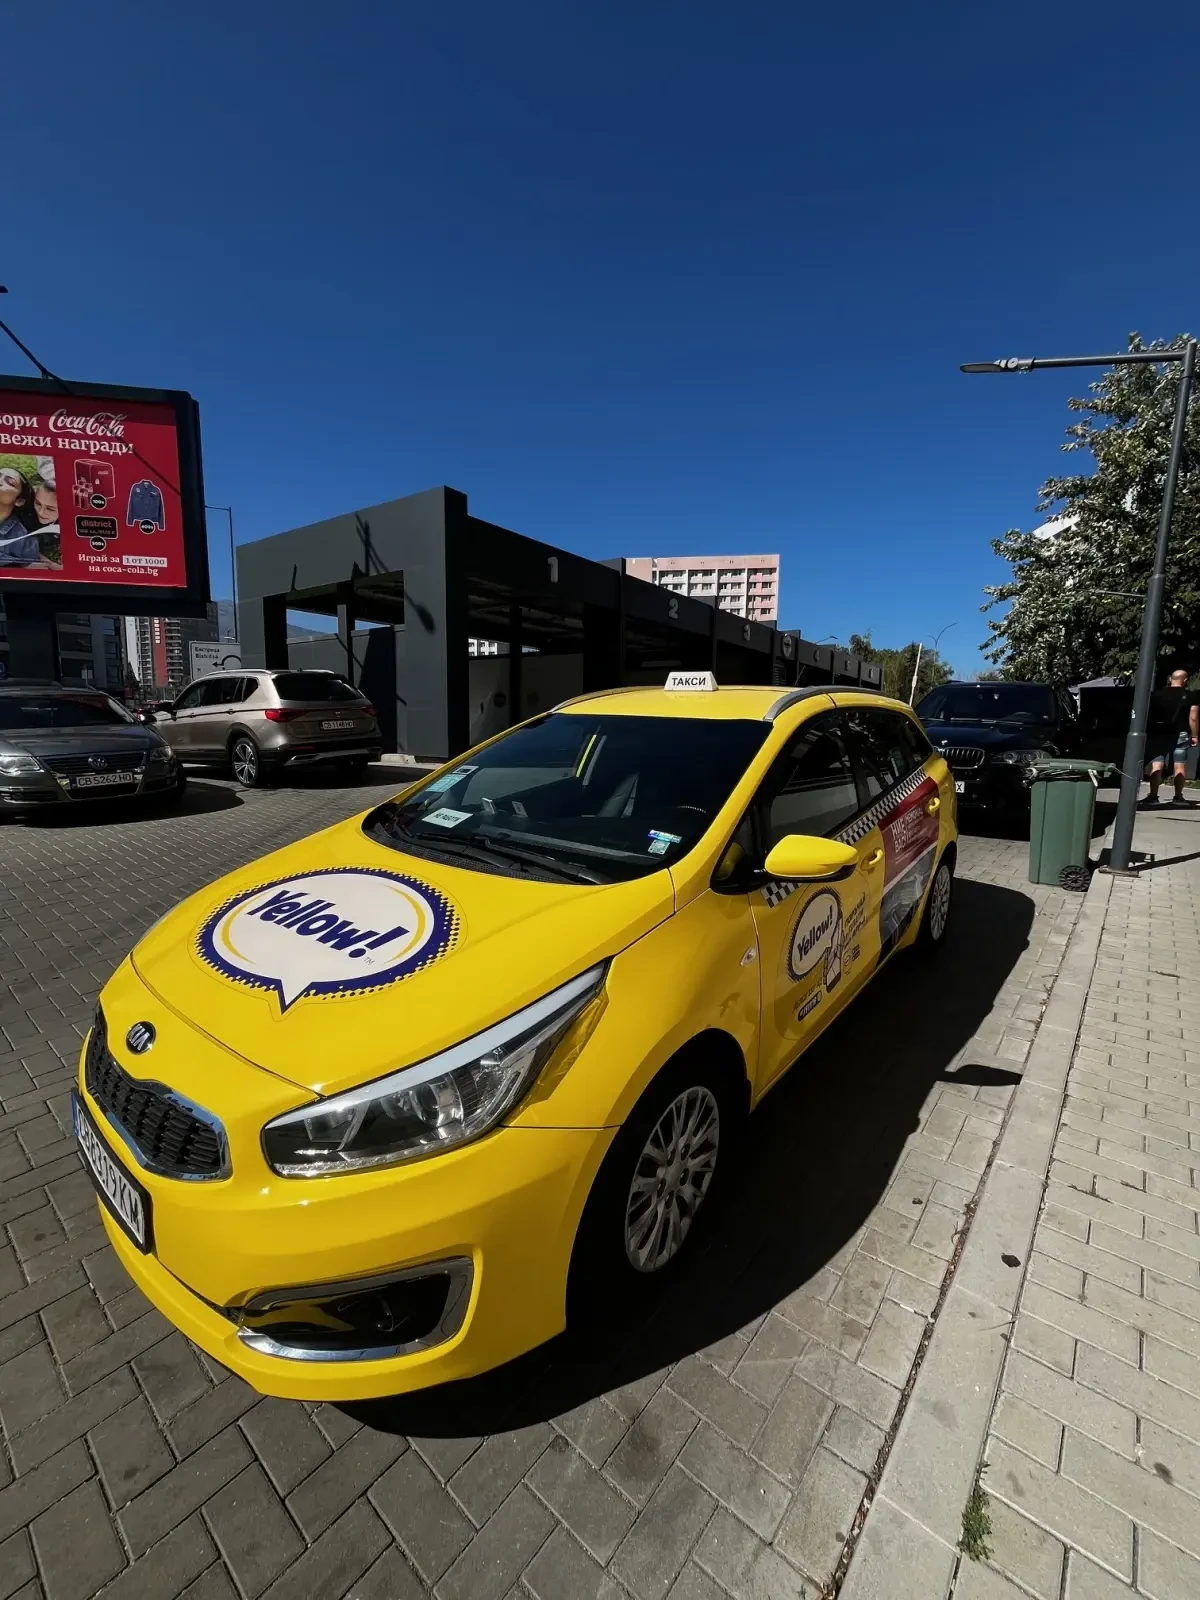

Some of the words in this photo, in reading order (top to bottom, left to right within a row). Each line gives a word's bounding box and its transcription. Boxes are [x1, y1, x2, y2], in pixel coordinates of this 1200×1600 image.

[0, 414, 38, 430] ори
[49, 408, 128, 437] Coca-Cola
[57, 437, 133, 456] награди
[81, 519, 113, 528] district
[78, 553, 108, 563] Играй
[145, 557, 166, 565] 1000
[88, 565, 101, 573] на
[102, 566, 159, 577] coca-cola.bg
[547, 556, 559, 583] 1
[668, 598, 680, 620] 2
[671, 677, 707, 687] ТАКСИ
[93, 774, 118, 785] 5262
[246, 889, 411, 959] Yellow!
[797, 904, 833, 962] Yellow!
